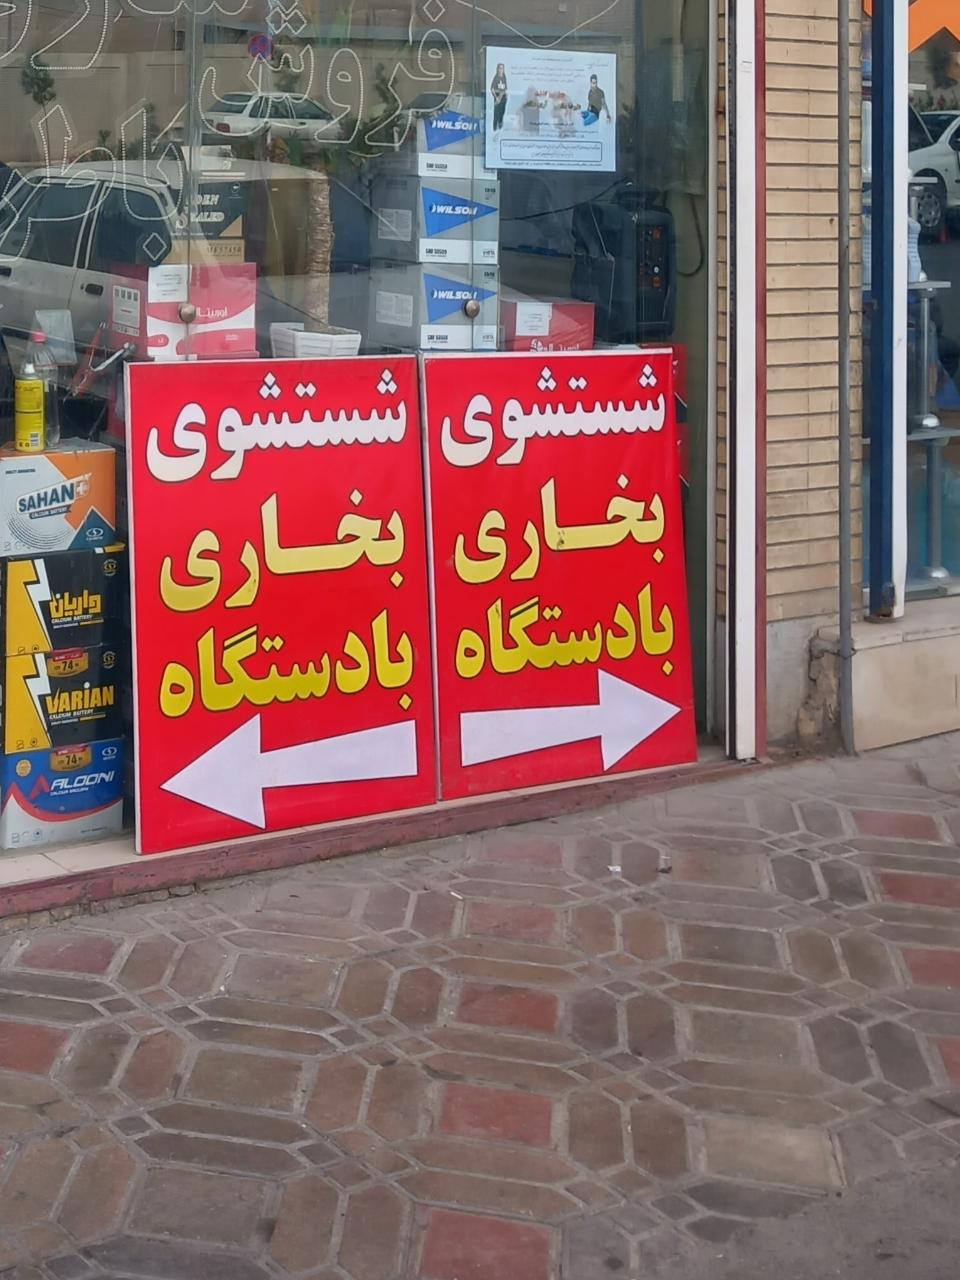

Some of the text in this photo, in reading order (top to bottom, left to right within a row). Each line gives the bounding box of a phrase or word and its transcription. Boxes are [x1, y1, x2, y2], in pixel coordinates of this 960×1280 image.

[437, 205, 479, 216] WILSON
[438, 291, 479, 300] WILSON
[145, 367, 407, 483] شستشوی
[440, 363, 666, 467] شستشوی
[453, 473, 666, 585] بخاری
[159, 488, 406, 612] بخاری
[48, 589, 102, 619] واریان
[61, 660, 74, 672] 74
[65, 753, 77, 766] 74
